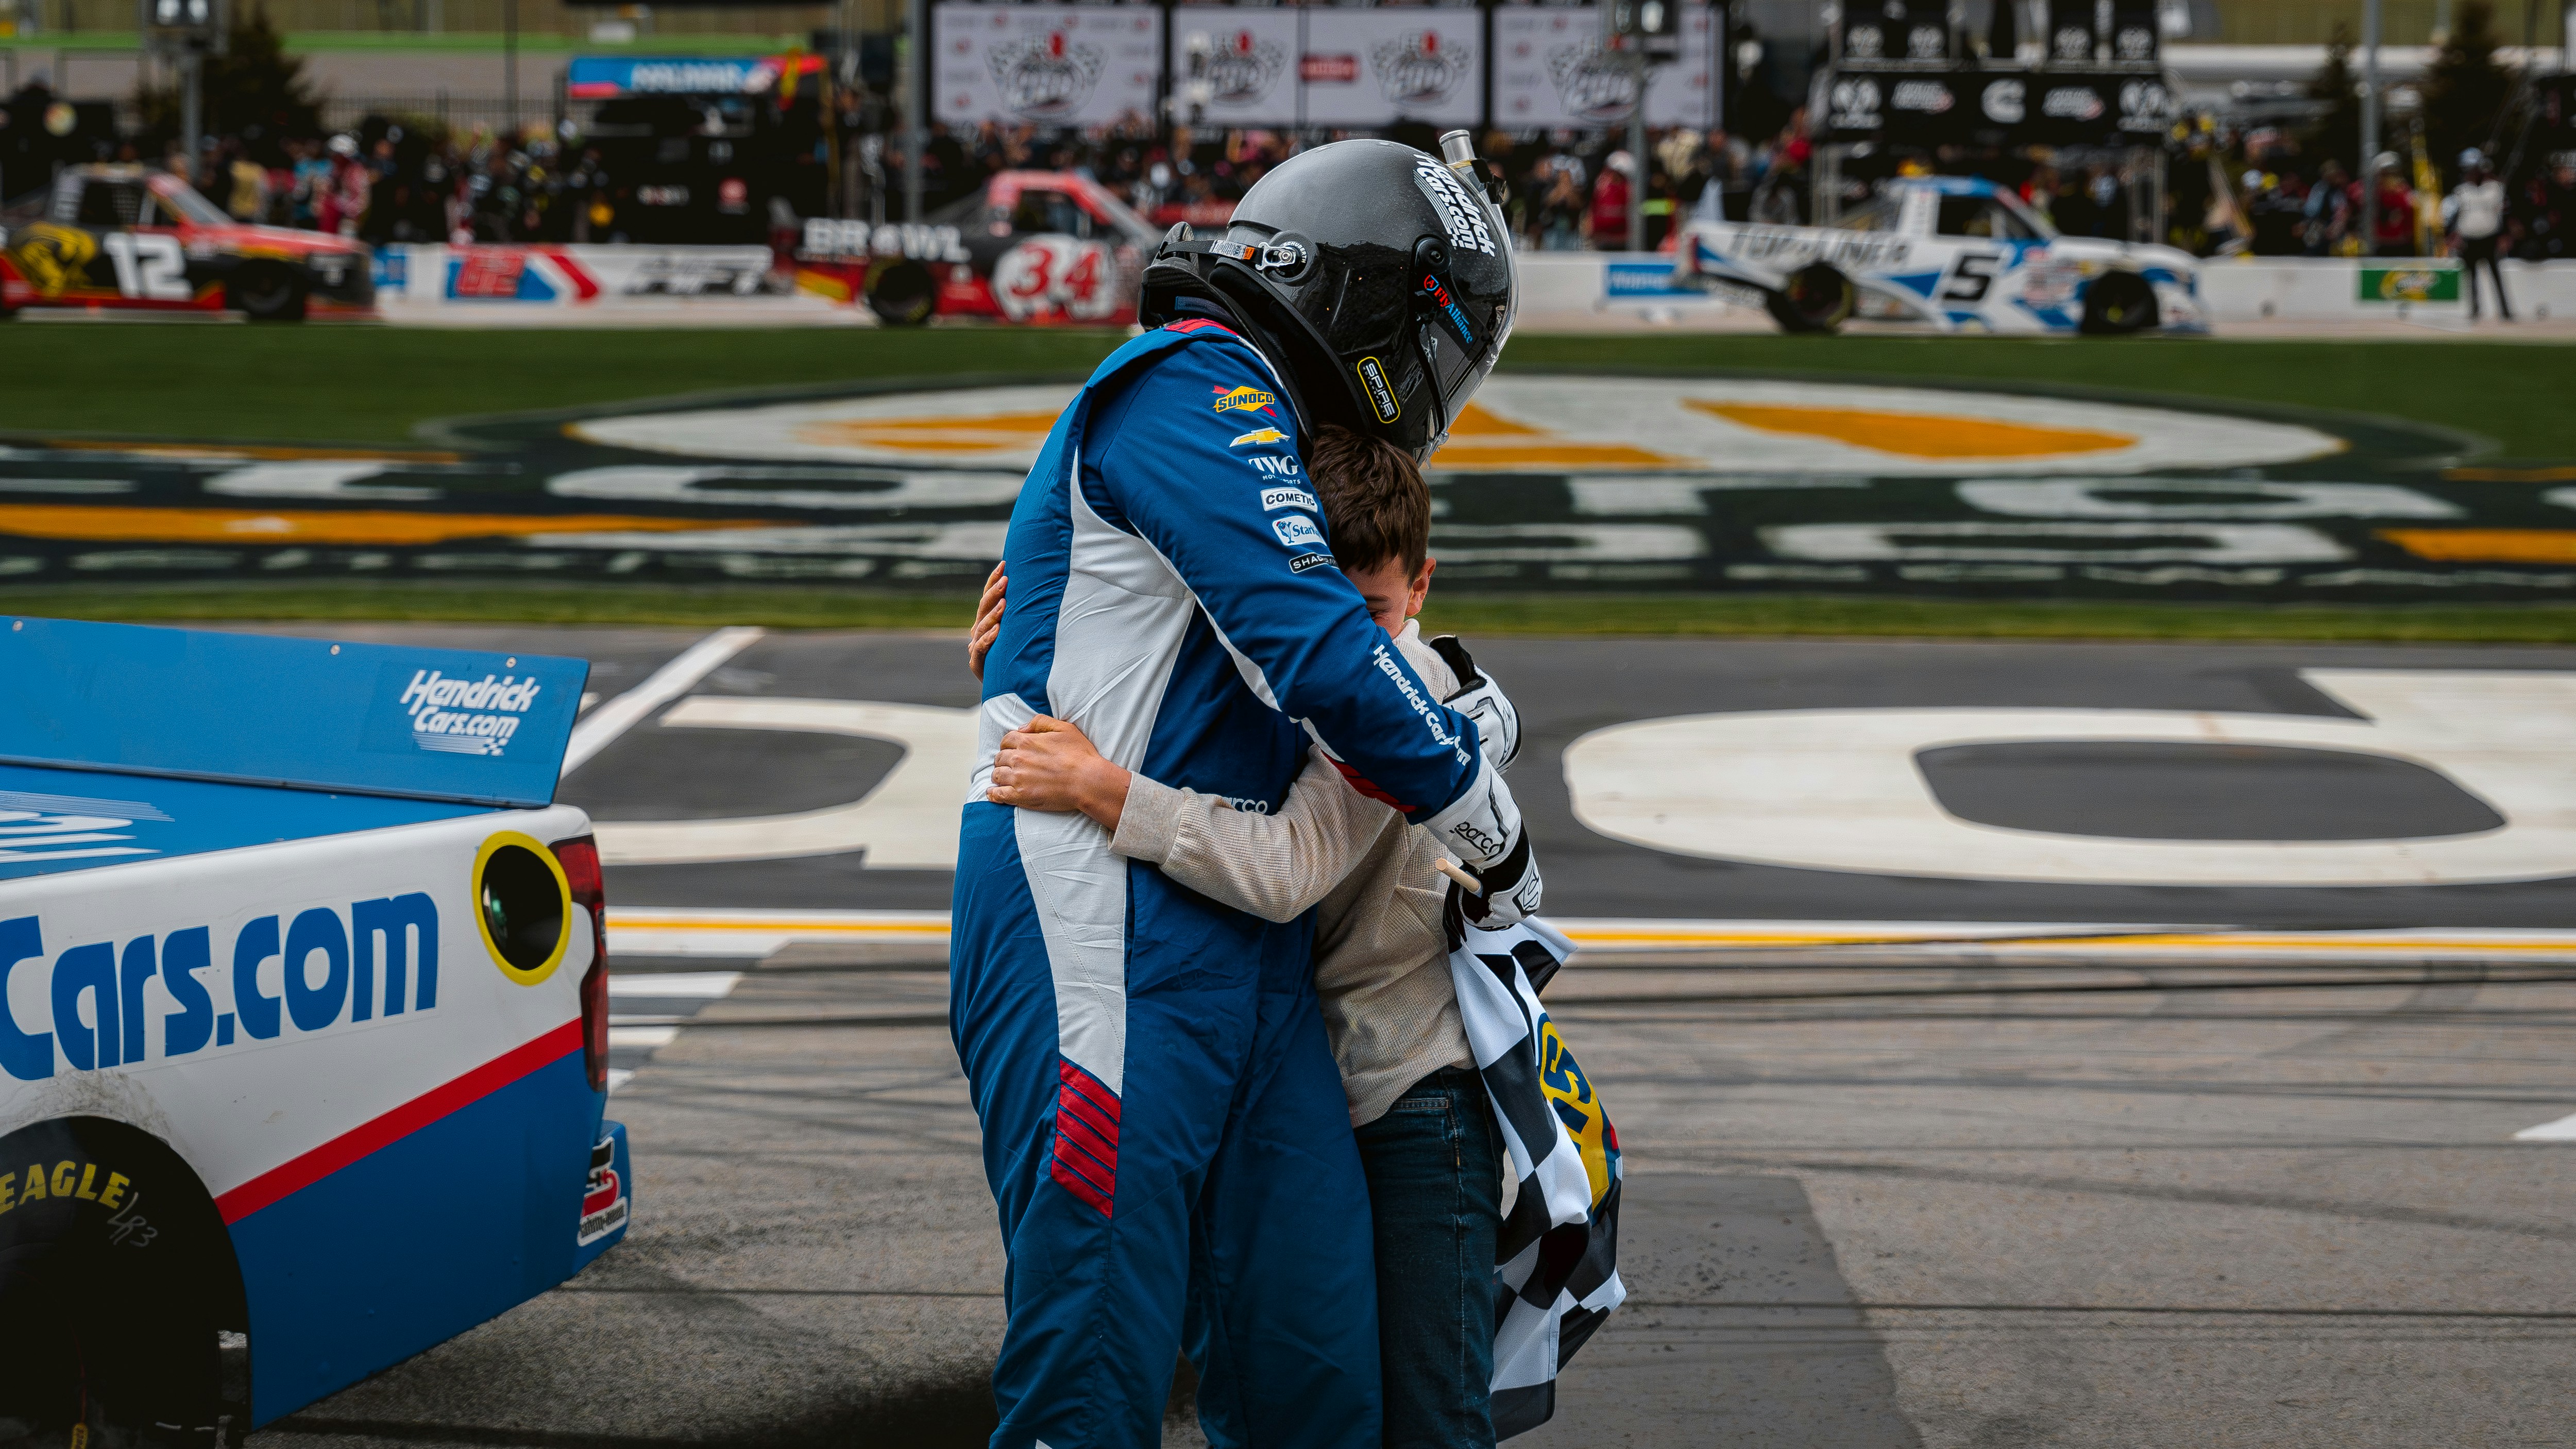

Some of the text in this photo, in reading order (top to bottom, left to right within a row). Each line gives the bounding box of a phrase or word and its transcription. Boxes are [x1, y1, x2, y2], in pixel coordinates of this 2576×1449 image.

[1413, 154, 1495, 257] Hendrick
[1416, 167, 1478, 250] Cars.com
[103, 232, 194, 301] 12
[1010, 240, 1104, 300] 34
[1283, 241, 1307, 263] SCHUBERTH
[1943, 255, 2001, 301] 5
[1434, 287, 1473, 344] FlyAlliance
[1218, 393, 1273, 411] SUNOCO
[1365, 363, 1395, 416] SPIRE
[1248, 456, 1298, 476] TWG
[1266, 493, 1315, 506] COMETIC
[400, 669, 540, 715] Hendrick
[414, 704, 520, 738] Cars.com
[0, 891, 439, 1081] Cars.com
[0, 1160, 131, 1215] EAGLE
